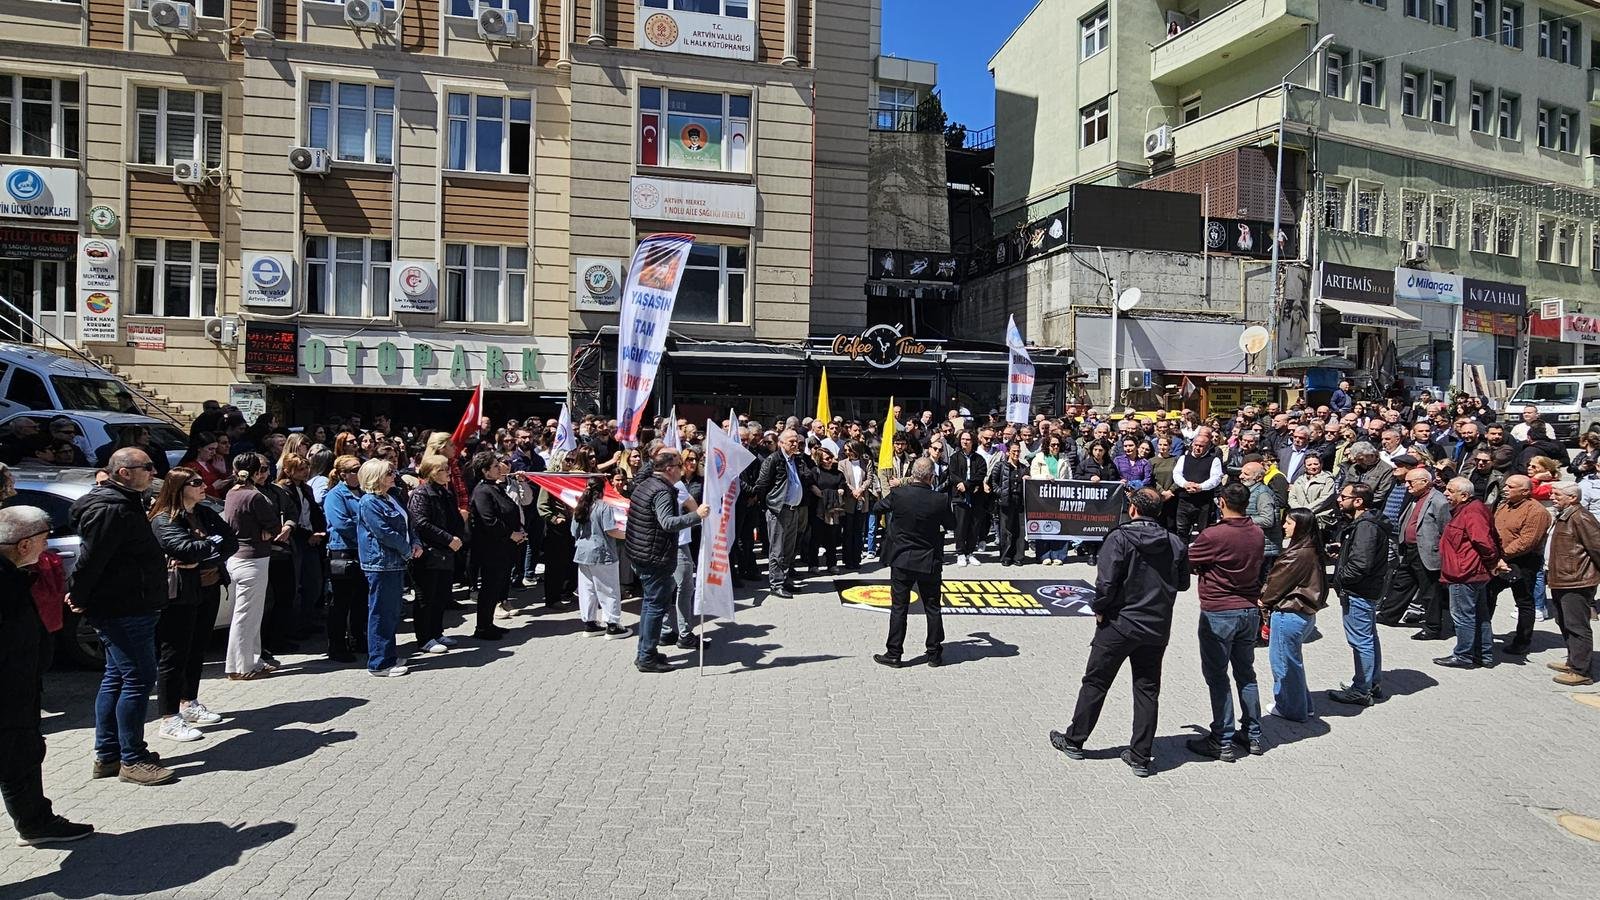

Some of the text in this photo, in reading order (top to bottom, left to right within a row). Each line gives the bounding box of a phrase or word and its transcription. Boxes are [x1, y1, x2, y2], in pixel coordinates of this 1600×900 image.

[717, 33, 743, 42] VALİLİĞİ
[708, 42, 751, 52] KÜTÜPHANESİ
[11, 203, 32, 215] ÜLKÜ
[33, 205, 71, 218] OCAKLARI
[669, 207, 685, 215] NOLU
[686, 206, 698, 216] AİLE
[1324, 273, 1390, 294] ARTEMİS HALI
[1416, 277, 1454, 295] Milangaz
[631, 290, 672, 312] YAŞASIN
[1498, 292, 1520, 306] HALI
[634, 319, 656, 337] TAM
[832, 334, 873, 360] Cafee
[895, 336, 927, 355] Time
[304, 338, 540, 382] OTOPARK
[1039, 483, 1077, 498] EĞİTİMDE
[1059, 500, 1086, 512] HAYIR!
[1082, 525, 1109, 533] #ARTVİN
